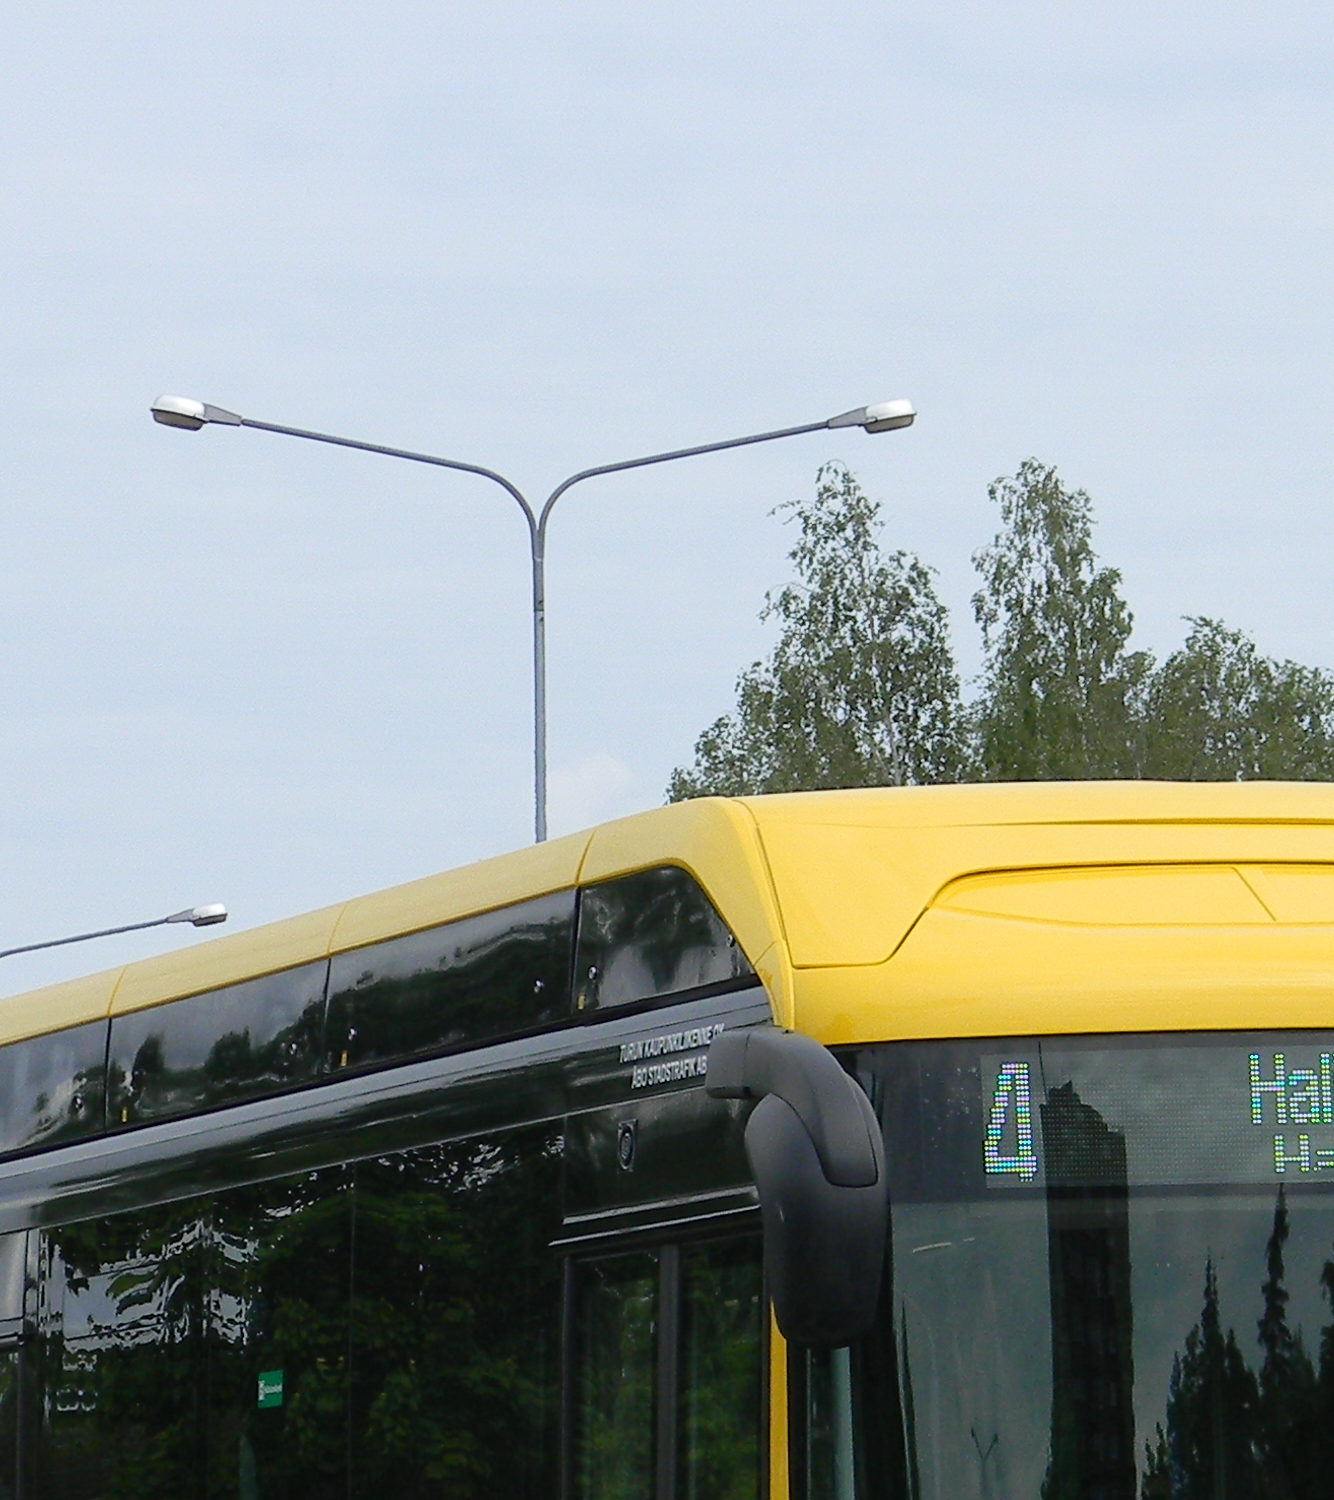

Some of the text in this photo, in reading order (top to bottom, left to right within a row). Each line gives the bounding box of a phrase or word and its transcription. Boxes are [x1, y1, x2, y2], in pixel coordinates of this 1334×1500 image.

[620, 1042, 644, 1063] TURUN
[631, 1055, 708, 1089] ÅBO STADSTRAFIK AB
[984, 1063, 1038, 1182] 4
